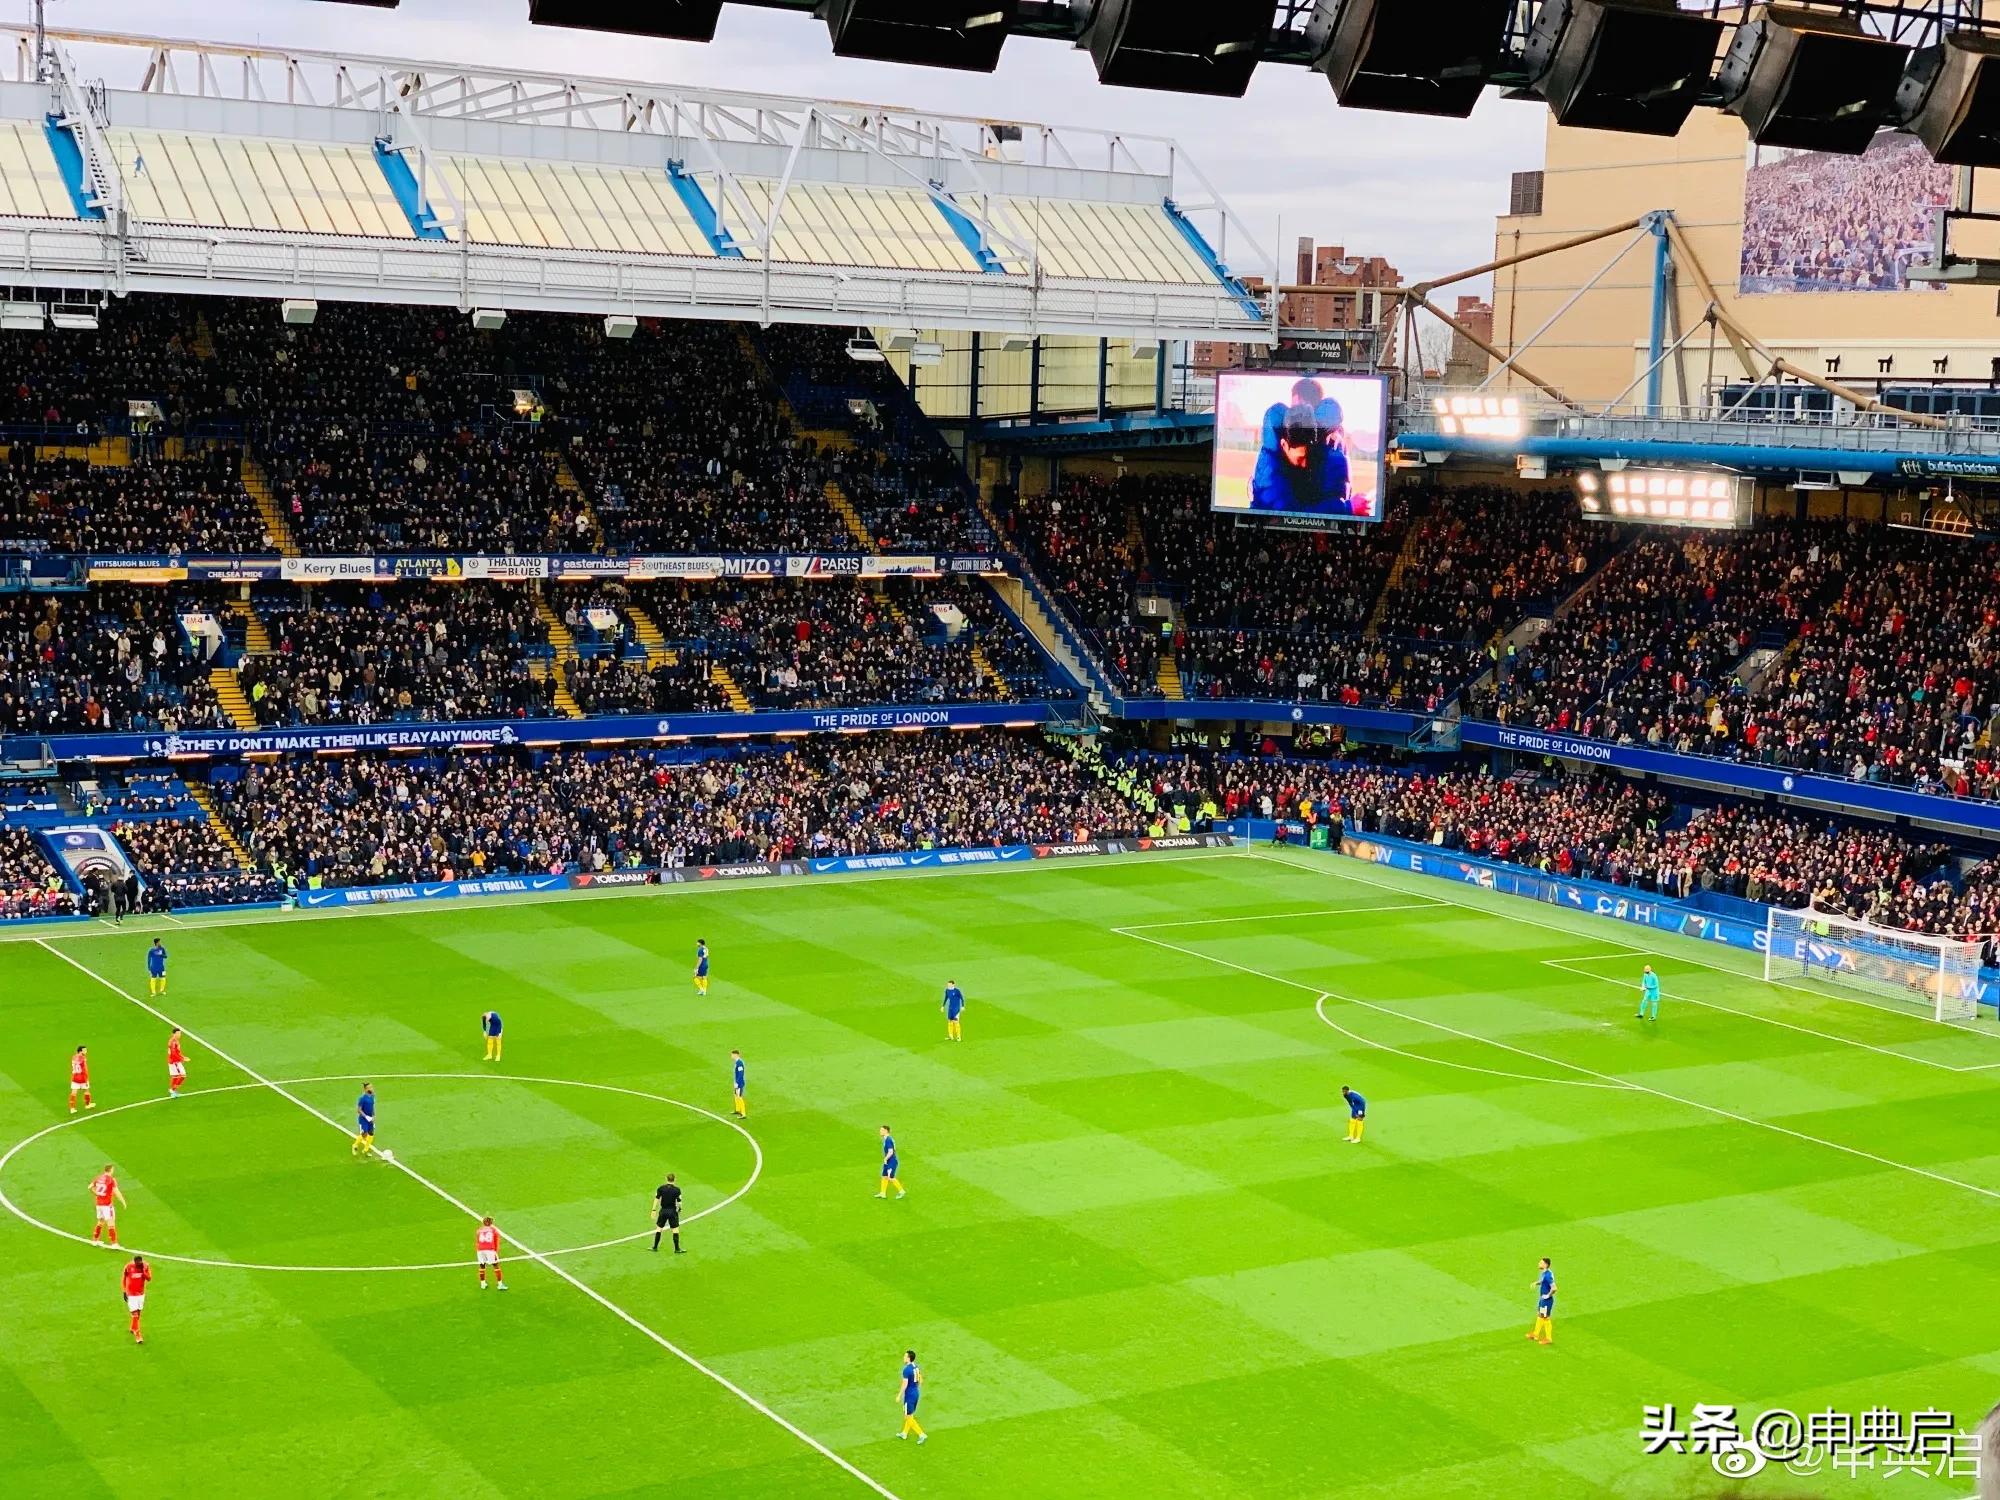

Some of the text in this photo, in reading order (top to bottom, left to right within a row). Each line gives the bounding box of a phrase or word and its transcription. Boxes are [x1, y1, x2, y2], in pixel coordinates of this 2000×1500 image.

[1296, 341, 1341, 351] YOKOHAMA
[1283, 517, 1326, 527] YOKOHAMA
[94, 560, 160, 568] PITTSBURGH BLUES
[395, 558, 442, 568] ATLANTA
[487, 558, 542, 567] THAILAND
[563, 558, 629, 569] easternblues
[641, 561, 710, 570] SOUTHEAST BLUES
[725, 558, 770, 574] MIZO
[821, 557, 860, 569] PARIS
[951, 560, 991, 571] AUSTIN BLUES
[207, 571, 240, 579] CHELSEA
[304, 563, 336, 576] Kerry
[339, 563, 371, 574] Blues
[395, 567, 442, 577] BLUES
[508, 567, 541, 577] BLUES
[813, 711, 949, 727] THE PRIDE OF LONDON
[184, 729, 501, 752] THEY DON'T MAKE THEM LIKE RAY ANYMORE
[1499, 731, 1611, 760] THE PRIDE OF LONDON
[1152, 837, 1199, 848] YOKOHAMA
[1050, 844, 1100, 855] YOKOHAMA
[846, 850, 998, 869] NIKE FOOTBALL NIKE FOOTBALL
[716, 865, 771, 876] YOKOHAMA
[595, 873, 649, 884] YOKOHAMA
[345, 891, 369, 902] NIKE
[458, 883, 480, 894] NIKE
[481, 879, 527, 893] FOOTBALL
